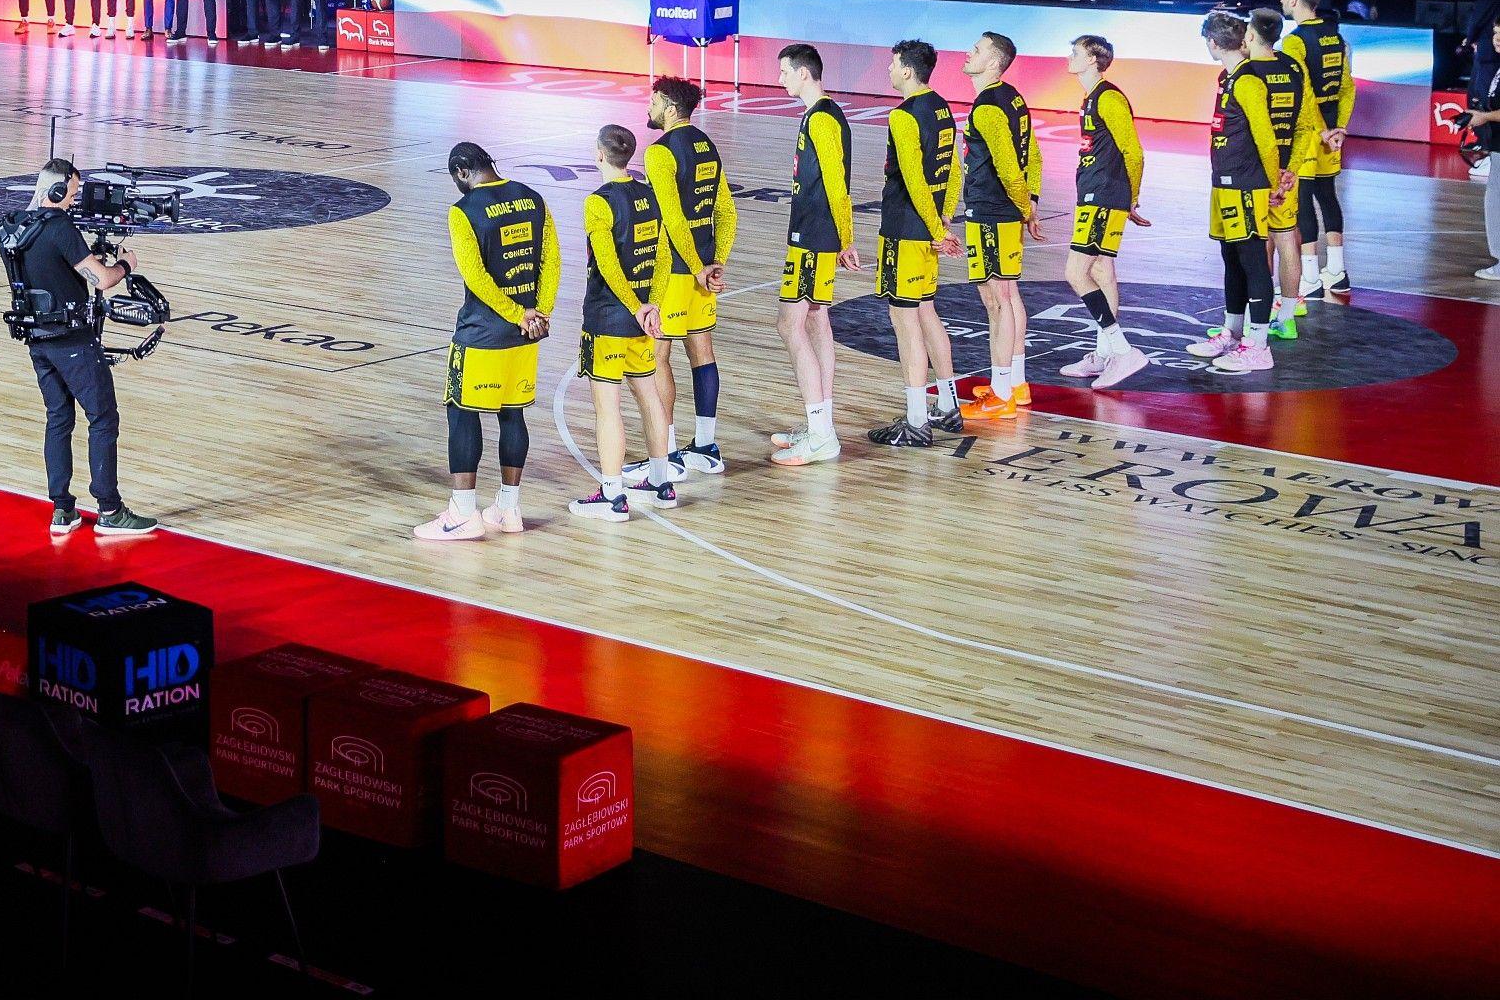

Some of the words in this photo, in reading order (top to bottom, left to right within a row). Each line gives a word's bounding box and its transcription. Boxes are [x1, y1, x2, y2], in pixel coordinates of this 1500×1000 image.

[655, 6, 698, 21] molten
[484, 198, 536, 219] ADDAE-WUSU
[510, 226, 529, 235] Energa
[169, 311, 375, 352] Pekao
[967, 467, 1121, 497] SWISS
[1132, 494, 1363, 540] WATCHES
[88, 597, 169, 618] RATION
[37, 632, 98, 692] HID
[124, 642, 200, 697] HID
[39, 678, 98, 713] RATION
[125, 683, 201, 716] RATION
[215, 747, 240, 763] PARK
[242, 755, 295, 778] SPORTOWY
[314, 776, 340, 792] PARK
[343, 785, 401, 809] SPORTOWY
[452, 815, 480, 832] PARK
[483, 823, 546, 849] SPORTOWY
[563, 797, 629, 836] ZAGŁĘBIOWSKI
[563, 834, 584, 850] PARK
[586, 813, 628, 841] SPORTOWY
